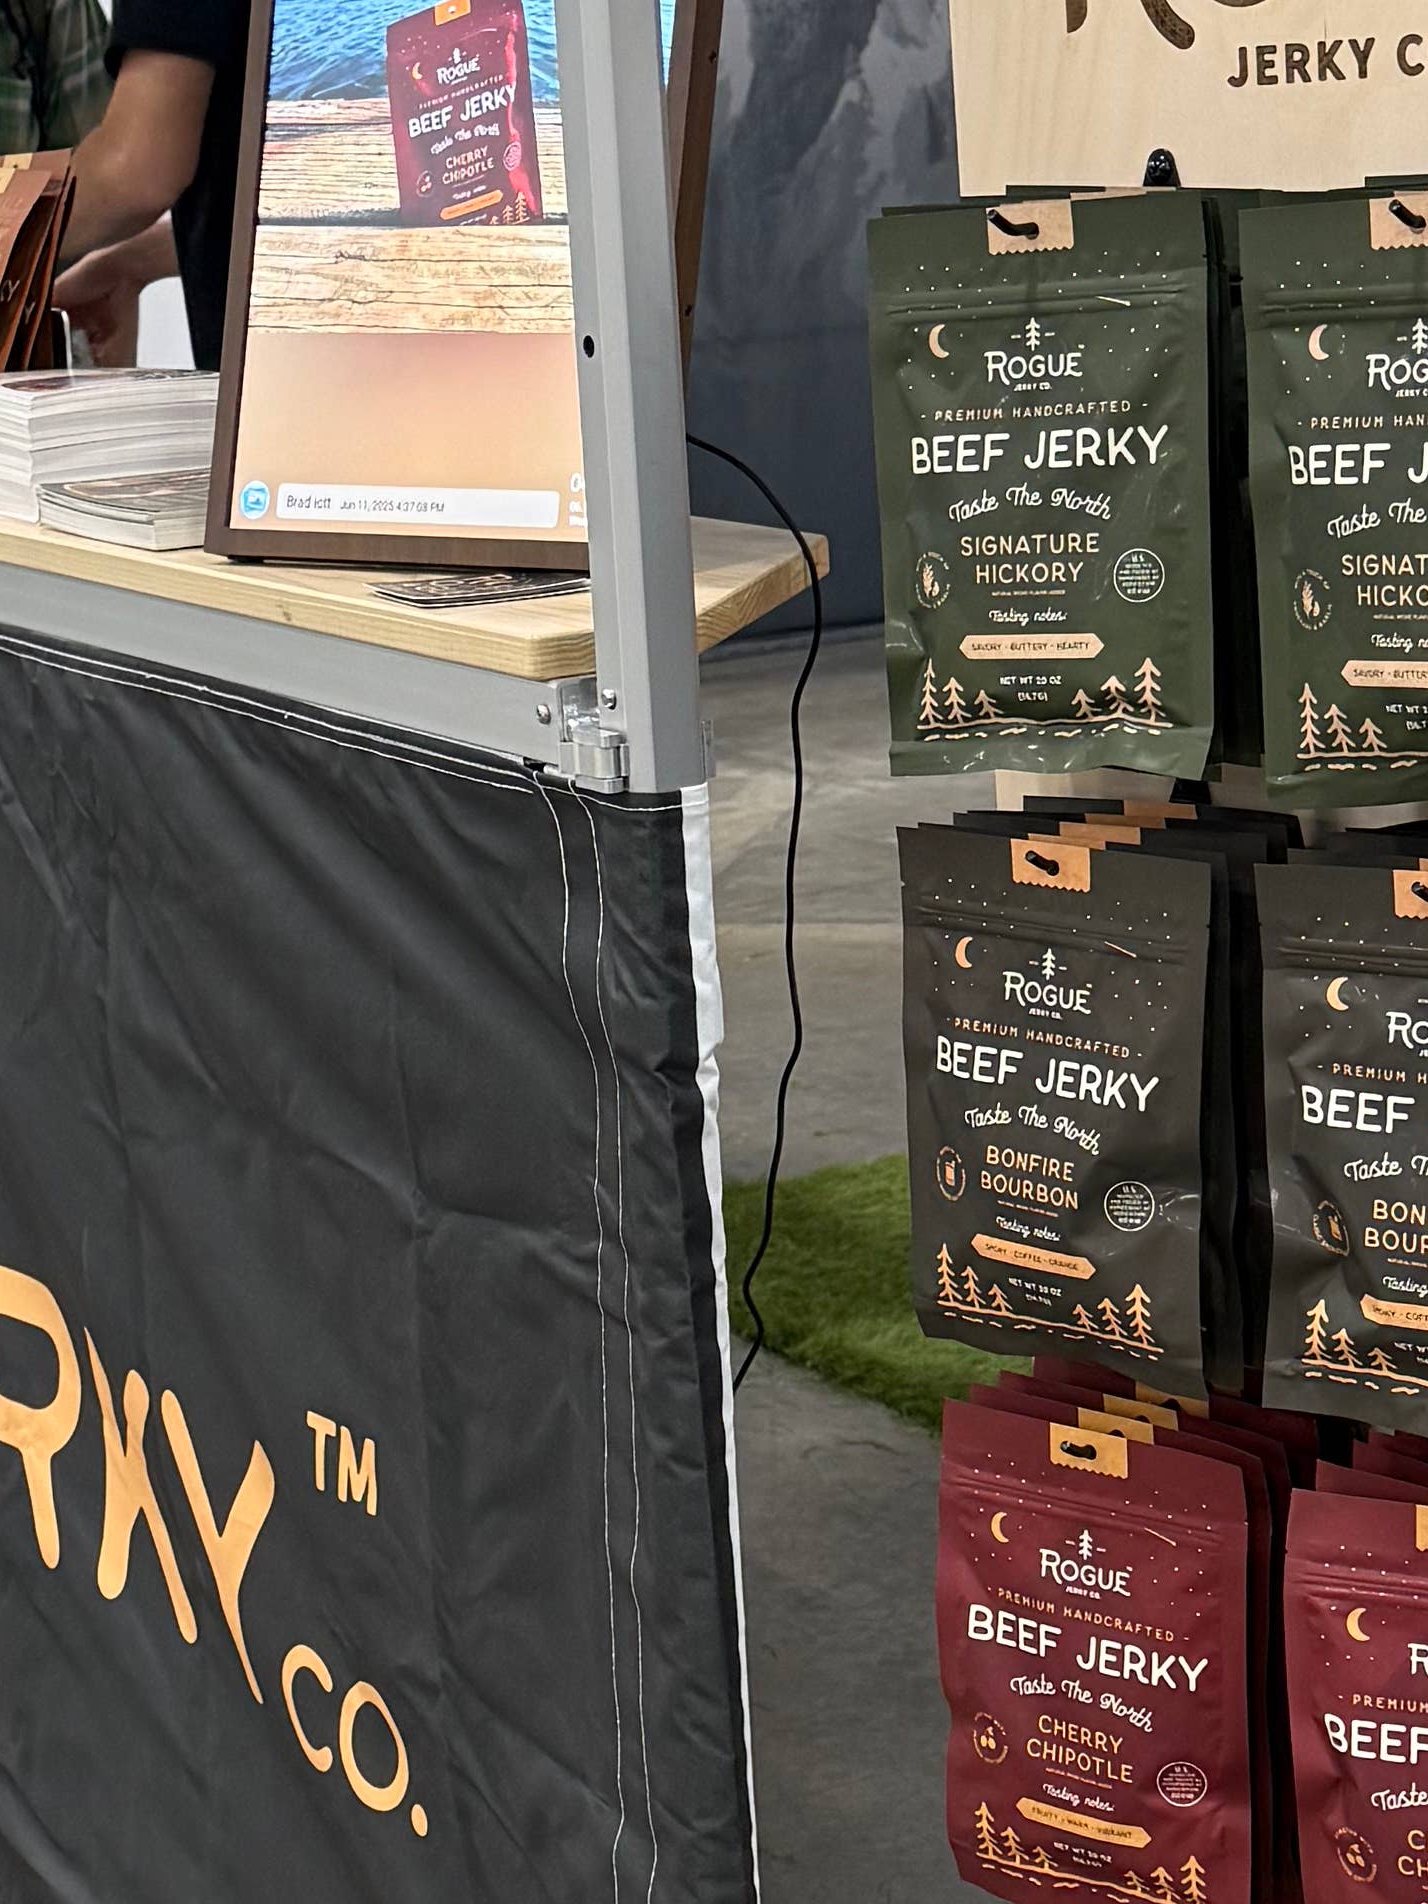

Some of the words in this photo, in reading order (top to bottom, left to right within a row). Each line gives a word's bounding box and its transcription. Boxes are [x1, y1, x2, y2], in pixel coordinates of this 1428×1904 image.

[436, 57, 481, 85] ROGUE
[1227, 36, 1377, 90] JERKY
[408, 105, 454, 138] BEEF
[460, 83, 517, 122] JERKY
[442, 157, 495, 185] CHIPOTLE
[445, 145, 489, 170] CHERRY
[983, 350, 1084, 386] ROGUE
[934, 406, 1004, 423] PREMIUM
[1012, 400, 1132, 419] HANDCRAFTED
[1310, 415, 1385, 430] PREMIUM
[911, 431, 1011, 475] BEEF
[1023, 424, 1169, 470] JERKY
[1287, 442, 1392, 486] BEEF
[948, 488, 1000, 524] Taste
[1005, 481, 1043, 506] The
[1050, 487, 1112, 521] North
[1327, 503, 1381, 539] Taste
[1388, 497, 1427, 524] The
[960, 532, 1101, 557] SIGNATURE
[975, 561, 1084, 585] HICKORY
[1002, 970, 1092, 1015] ROGUE
[954, 1017, 1019, 1038] PREMIUM
[1025, 1030, 1130, 1059] HANDCRAFTED
[936, 1035, 1024, 1085] BEEF
[1034, 1058, 1160, 1113] JERKY
[1332, 1062, 1407, 1083] PREMIUM
[964, 1102, 1012, 1128] Taste
[1018, 1104, 1049, 1129] The
[1053, 1115, 1101, 1156] North
[1301, 1084, 1416, 1134] BEEF
[985, 1144, 1075, 1182] BONFIRE
[1343, 1151, 1403, 1182] Taste
[980, 1170, 1079, 1211] BOURBON
[306, 1408, 378, 1517] TM
[1038, 1548, 1132, 1597] ROGUE
[997, 1587, 1055, 1614] PREMIUM
[1063, 1606, 1174, 1642] HANDCRAFTED
[967, 1603, 1063, 1658] BEEF
[1075, 1636, 1209, 1693] JERKY
[1009, 1673, 1057, 1696] Taste
[1060, 1679, 1094, 1704] The
[1099, 1692, 1154, 1734] North
[280, 1643, 430, 1839] CO.
[1038, 1714, 1123, 1755] CHERRY
[1026, 1737, 1134, 1784] CHIPOTLE
